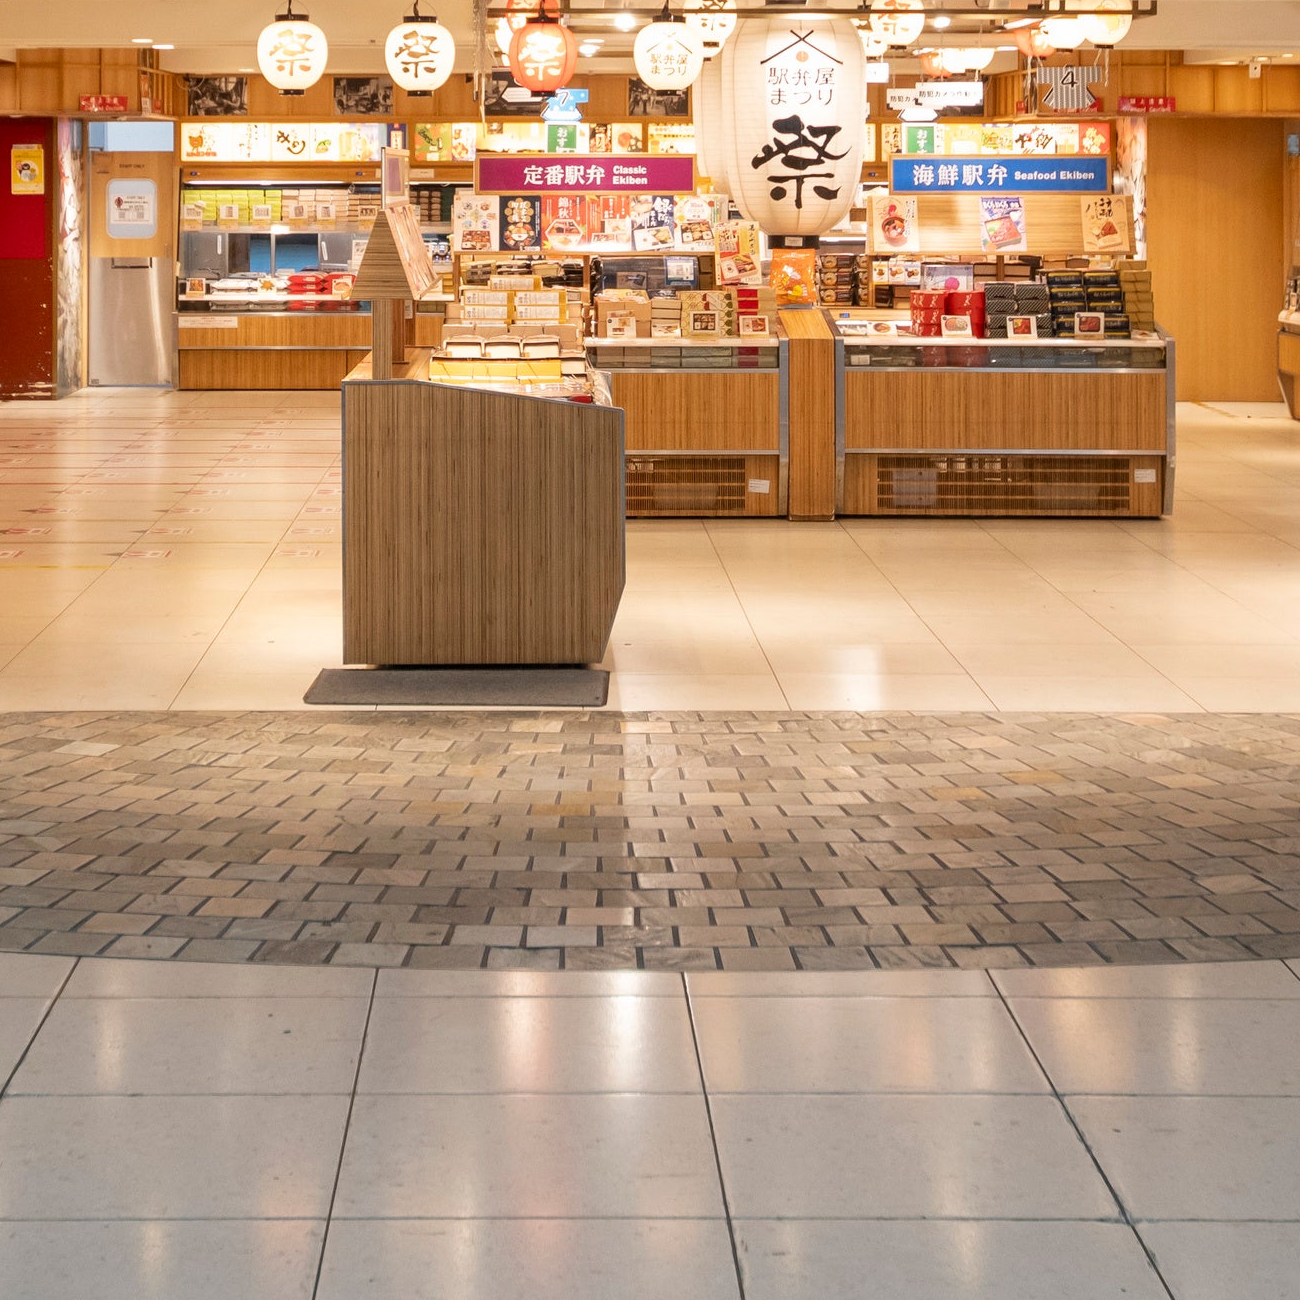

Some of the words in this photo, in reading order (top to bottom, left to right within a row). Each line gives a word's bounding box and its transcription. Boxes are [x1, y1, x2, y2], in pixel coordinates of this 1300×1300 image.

[269, 29, 316, 77] 祭
[394, 30, 444, 78] 祭
[516, 31, 567, 80] 祭
[650, 53, 689, 65] 駅弁屋
[650, 65, 688, 76] まつり
[767, 67, 835, 86] 駅弁屋
[1061, 71, 1078, 88] 4
[770, 88, 834, 106] まつり
[612, 165, 647, 175] Classic
[751, 114, 852, 209] 祭
[523, 164, 606, 186] 定番駅弁
[612, 175, 648, 185] Ekiben
[913, 163, 1009, 187] 海鮮駅弁
[1014, 170, 1056, 181] Seafood
[1060, 170, 1095, 181] Ekiben
